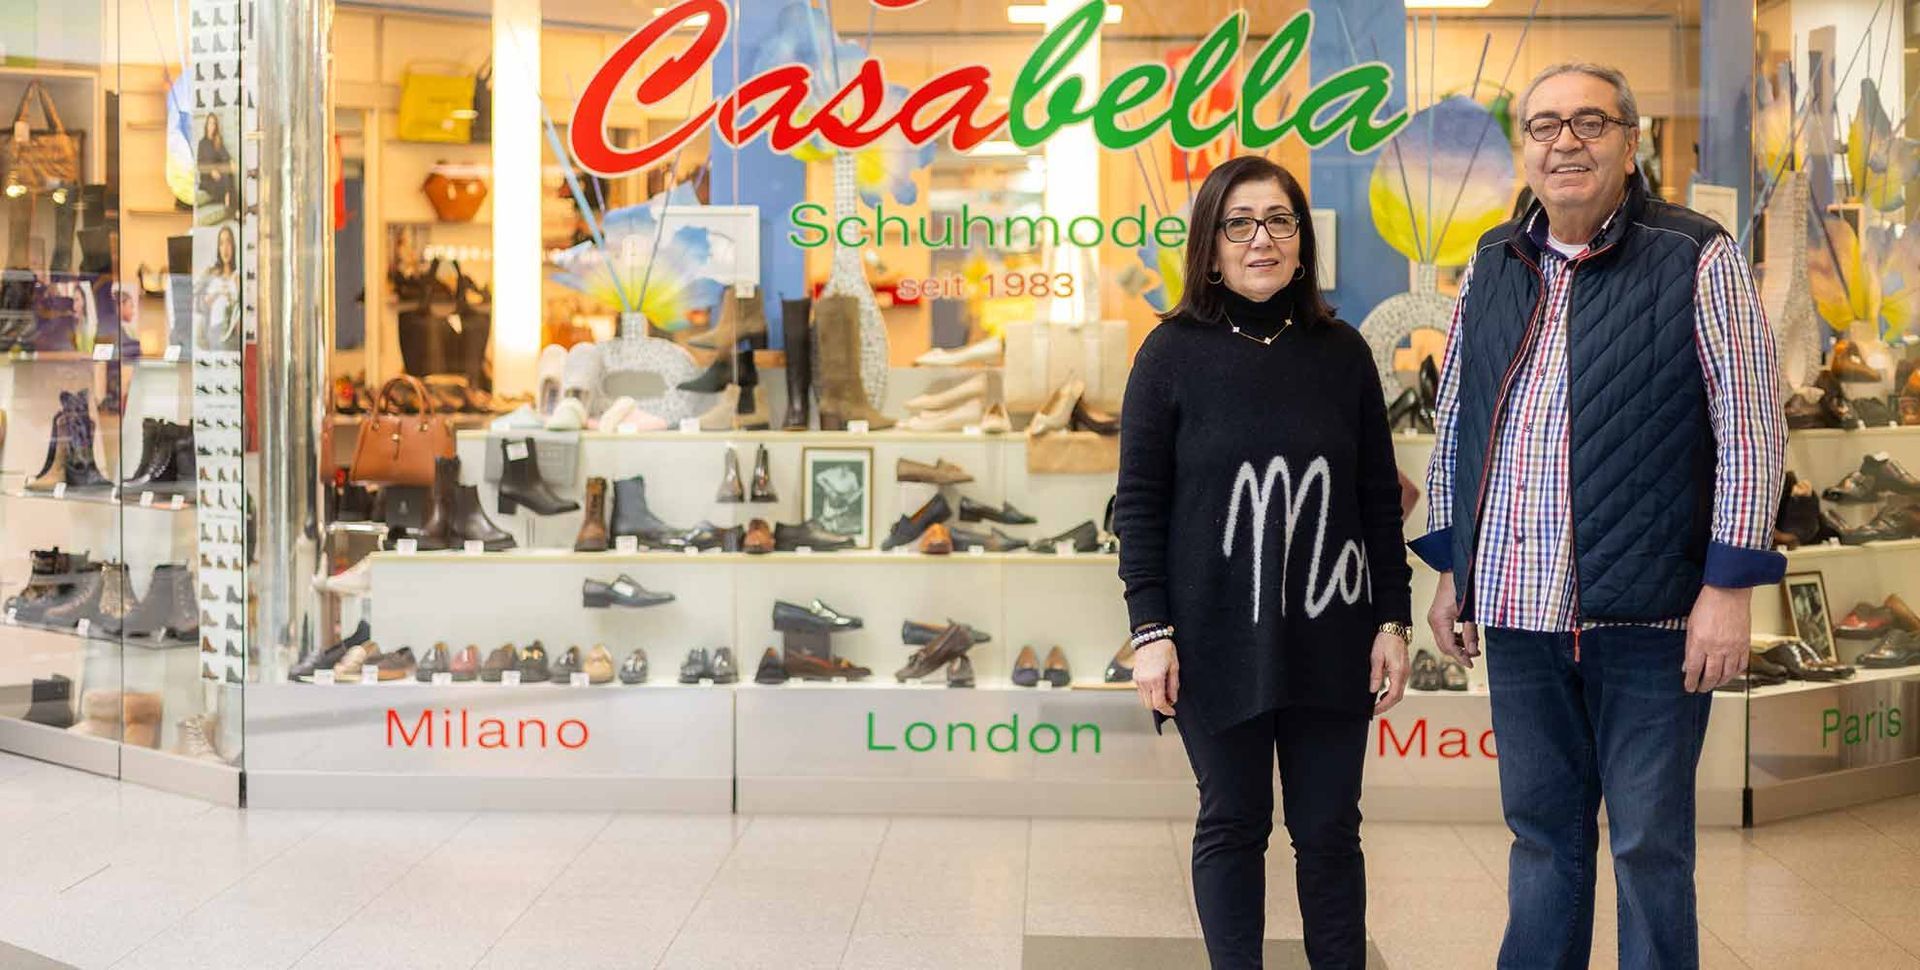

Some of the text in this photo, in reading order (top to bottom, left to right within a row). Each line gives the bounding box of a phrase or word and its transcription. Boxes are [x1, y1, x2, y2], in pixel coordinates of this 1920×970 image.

[570, 0, 1409, 176] Casabella
[790, 203, 1187, 249] Schuhmode
[899, 272, 1075, 299] seit 1983
[386, 708, 590, 750] Milano
[867, 713, 1102, 754] London
[1822, 701, 1902, 748] Paris
